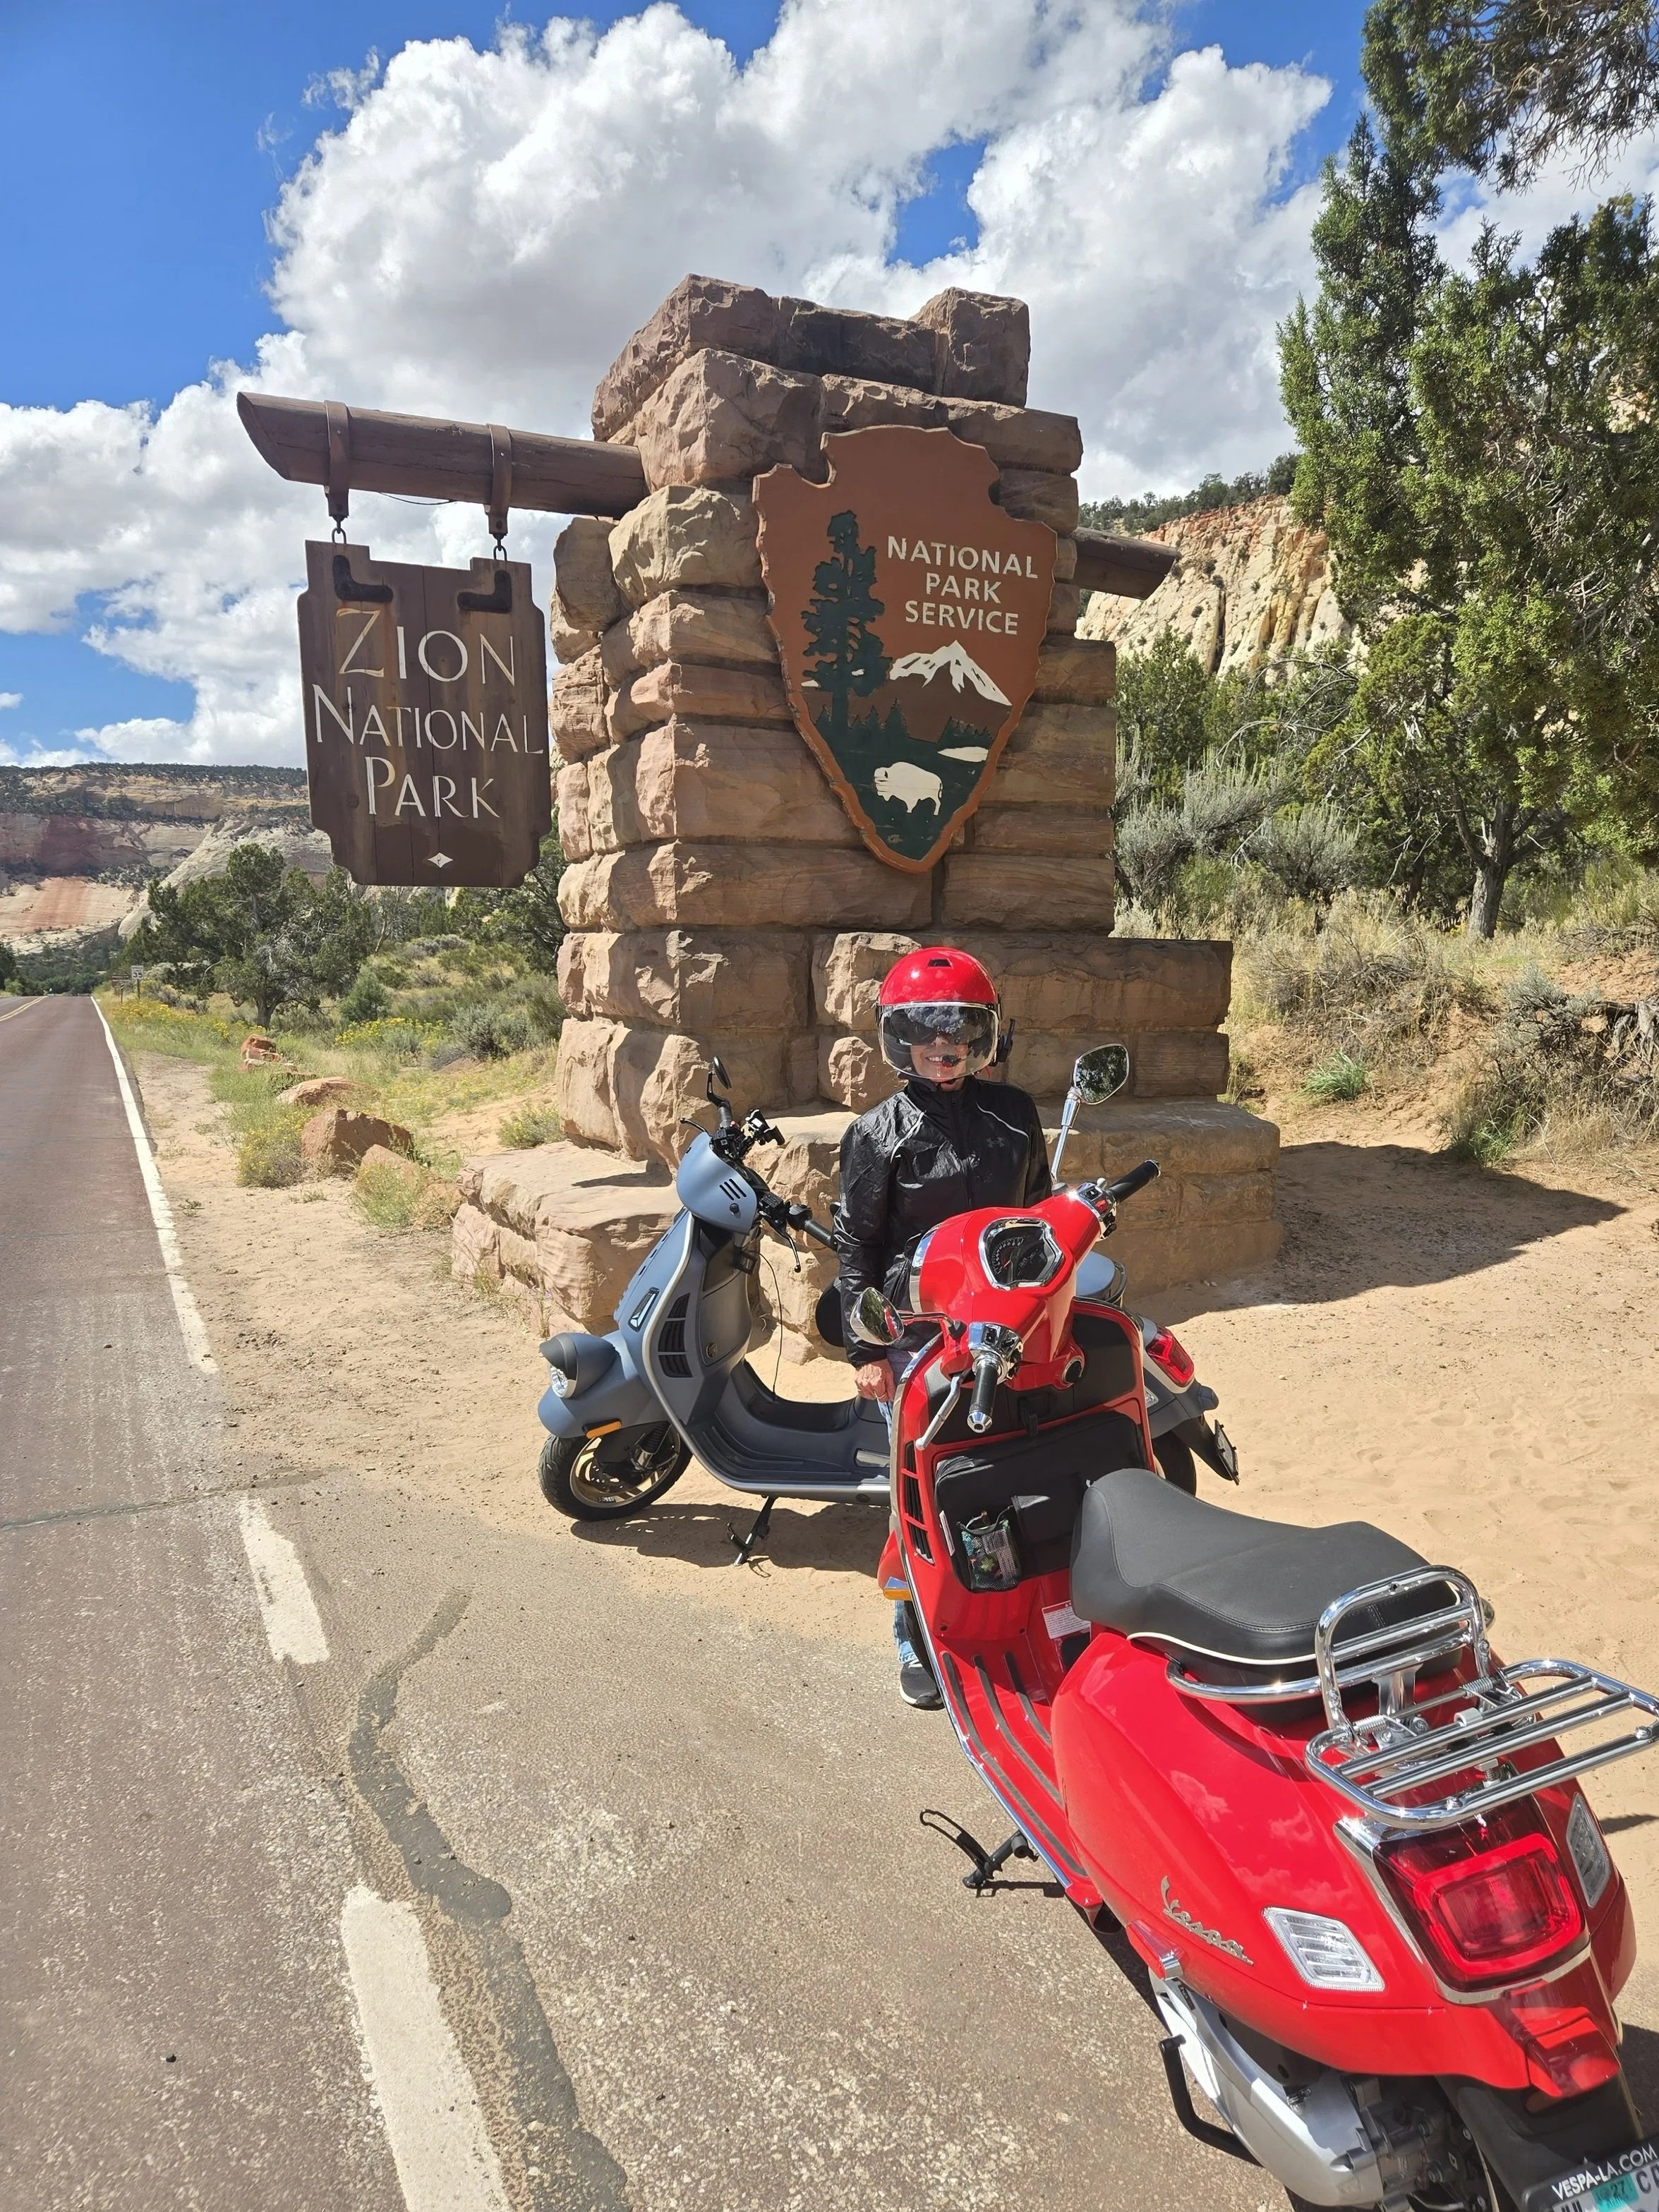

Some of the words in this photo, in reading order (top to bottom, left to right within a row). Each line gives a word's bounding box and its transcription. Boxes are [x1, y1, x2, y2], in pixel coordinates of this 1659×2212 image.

[888, 536, 1038, 579] NATIONAL
[926, 572, 1001, 603] PARK
[337, 608, 514, 685] ZION
[905, 600, 1019, 635] SERVICE
[313, 684, 544, 754] NATIONAL
[365, 756, 500, 818] PARK
[1160, 1875, 1254, 1965] Vespa
[1551, 2142, 1658, 2201] VESPA-LA.COM
